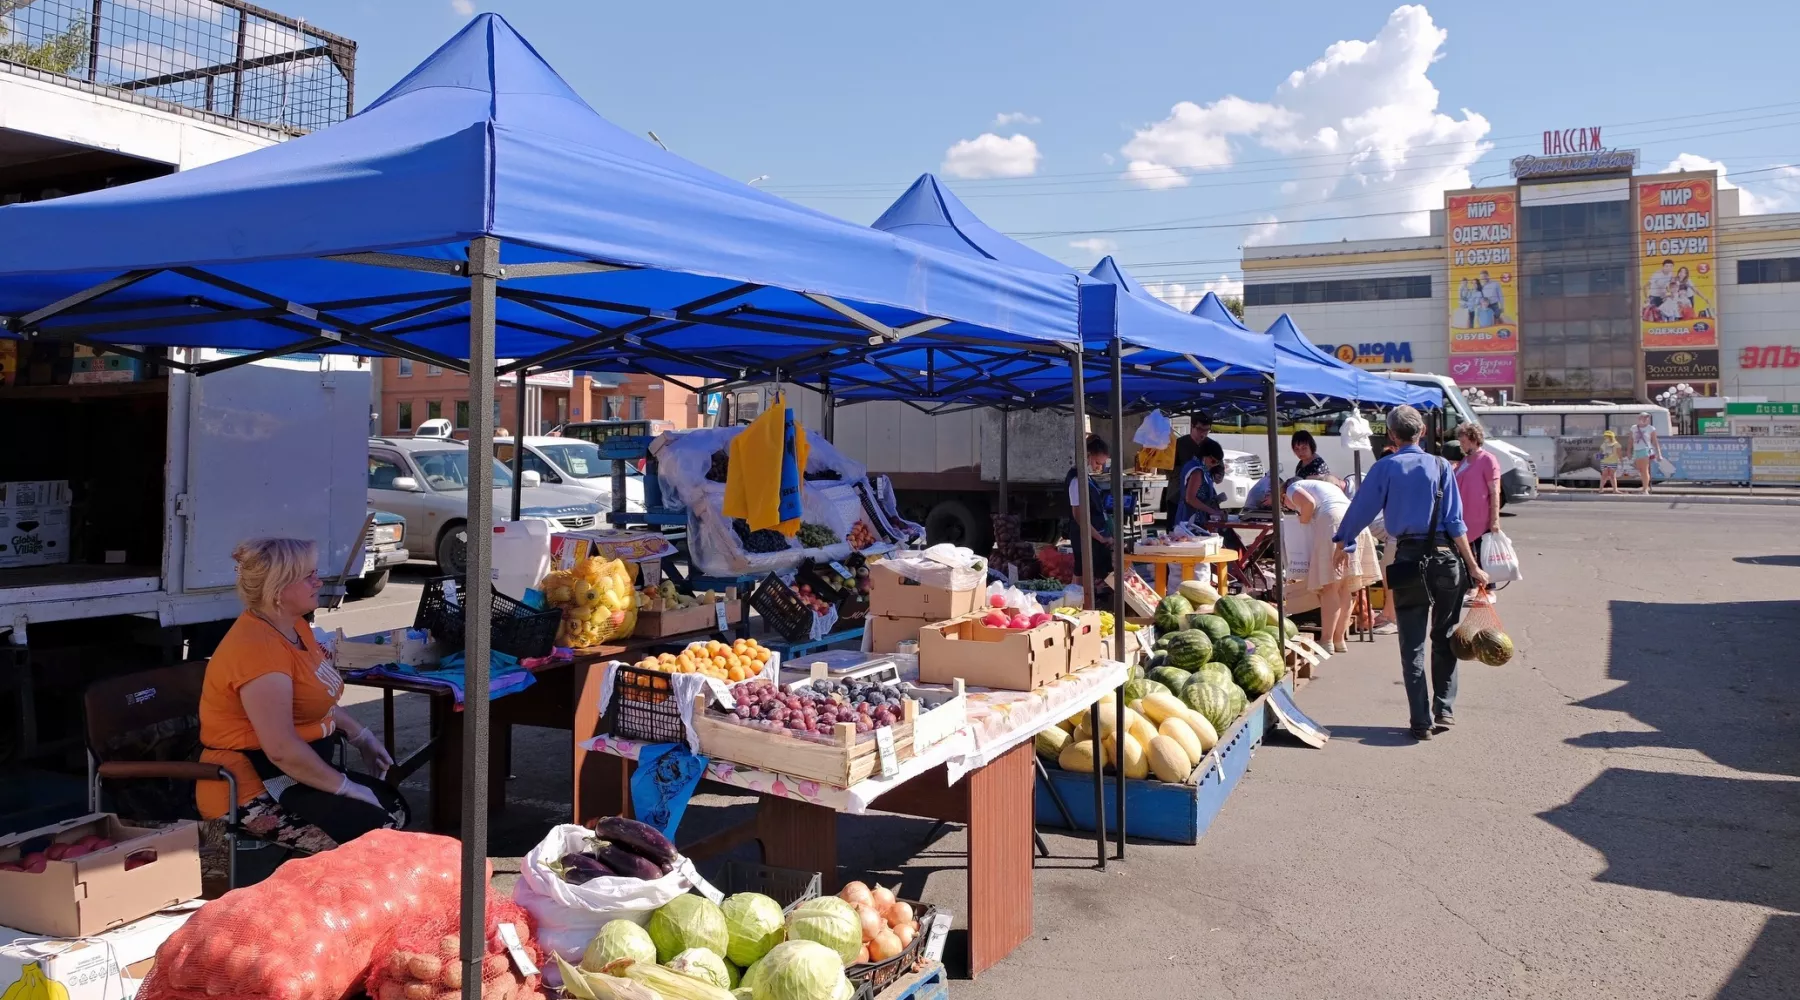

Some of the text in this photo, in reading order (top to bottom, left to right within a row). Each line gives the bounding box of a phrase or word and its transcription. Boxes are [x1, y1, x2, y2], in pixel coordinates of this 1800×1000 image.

[1543, 126, 1601, 155] ПАССАЖ
[1660, 188, 1692, 206] МИР
[1467, 201, 1496, 218] МИР
[1643, 211, 1710, 234] ОДЕЖДЫ
[1453, 223, 1512, 245] ОДЕЖДЫ
[1646, 236, 1708, 257] И ОБУВИ
[1455, 246, 1511, 266] И ОБУВИ
[1455, 333, 1493, 341] ОБУВЬ
[1648, 327, 1690, 335] ОДЕЖДА
[11, 533, 43, 546] Global
[13, 542, 44, 555] Village
